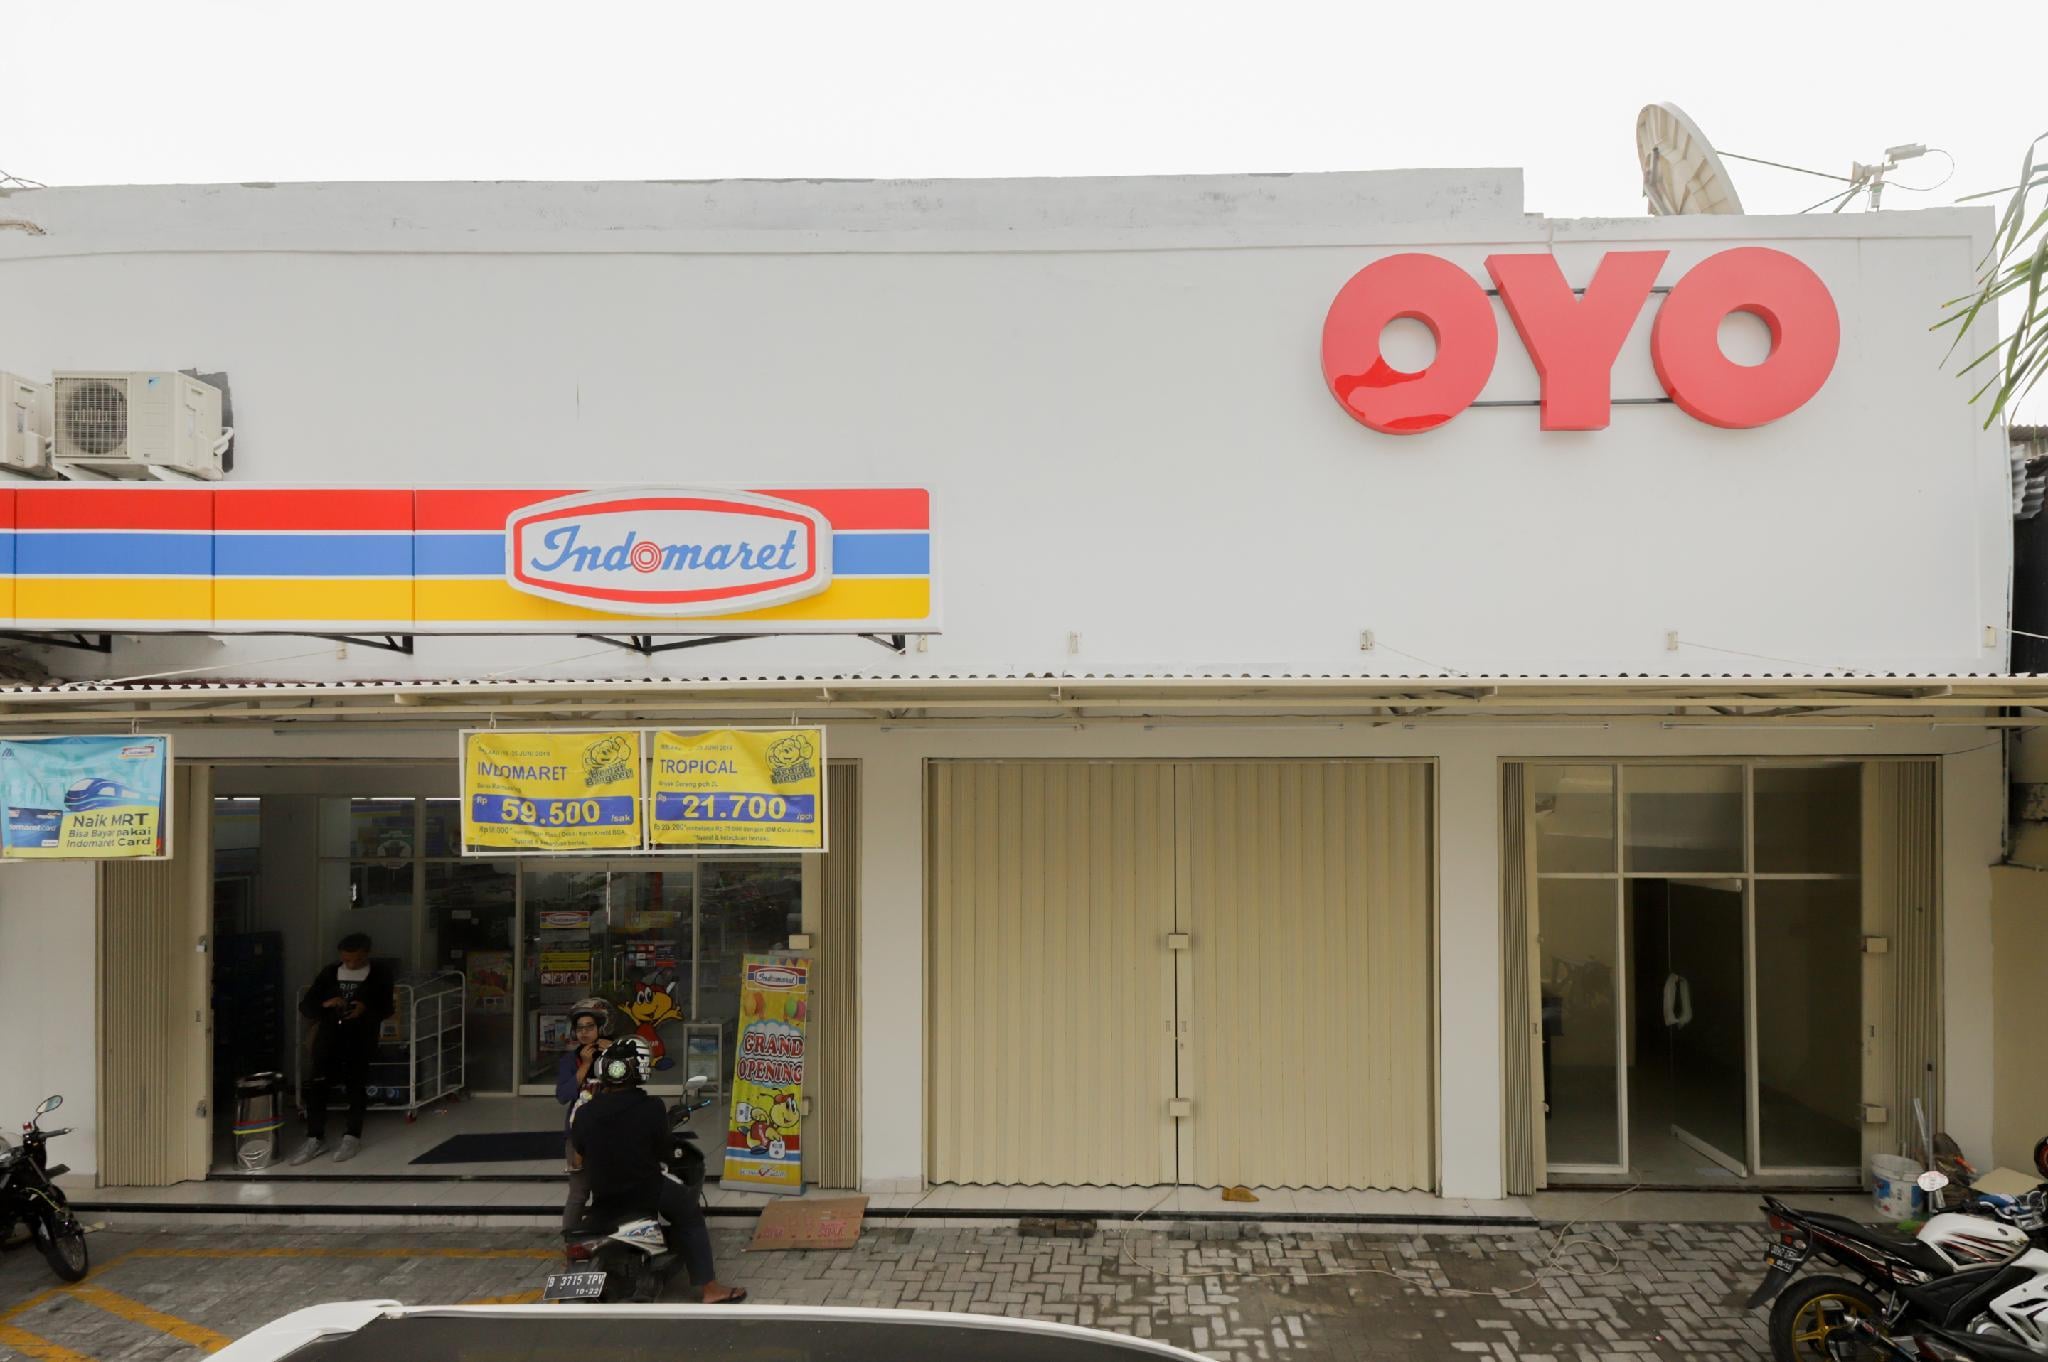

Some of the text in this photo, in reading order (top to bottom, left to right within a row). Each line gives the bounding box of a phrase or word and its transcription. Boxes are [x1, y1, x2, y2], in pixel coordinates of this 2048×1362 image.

[1320, 246, 1840, 436] OYO
[531, 524, 797, 573] Indomaret
[660, 759, 738, 774] TROPICAL
[476, 797, 488, 806] Rp
[501, 798, 600, 826] 59.500
[682, 794, 787, 819] 21.700
[68, 830, 89, 838] Bisa
[117, 827, 152, 839] pakai
[73, 812, 150, 829] Naik MRT
[66, 839, 115, 848] Indomaret
[118, 837, 151, 847] Card
[743, 1032, 804, 1058] GRAND
[737, 1057, 803, 1085] OPENING
[548, 1276, 556, 1288] B
